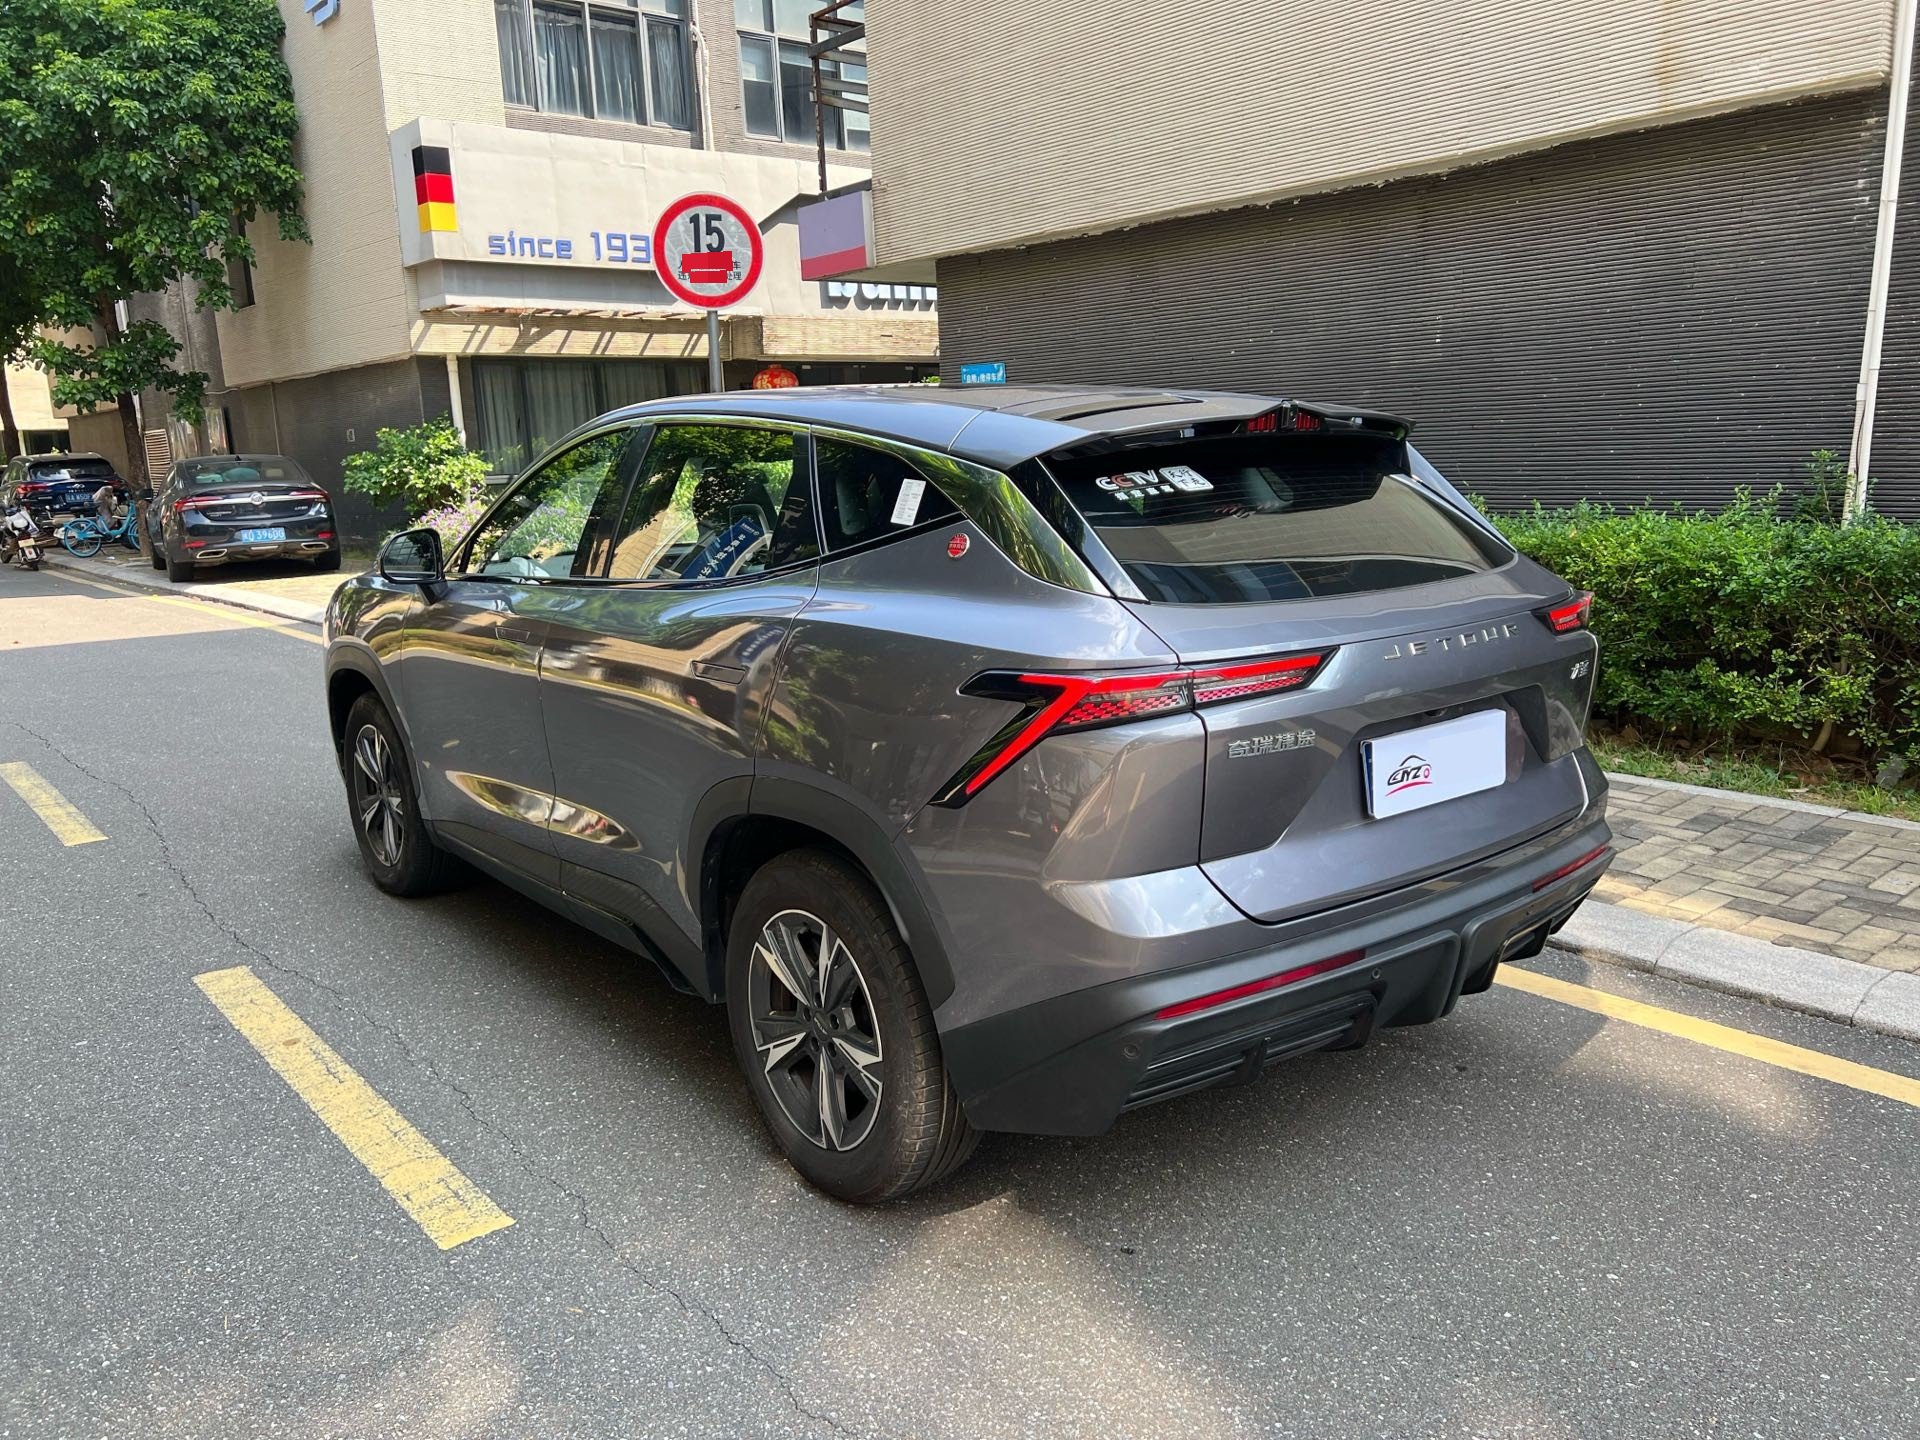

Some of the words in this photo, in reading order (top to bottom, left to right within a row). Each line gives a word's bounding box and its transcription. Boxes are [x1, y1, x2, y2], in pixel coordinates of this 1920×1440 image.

[488, 230, 572, 259] since
[590, 231, 651, 263] 193
[689, 213, 725, 253] 15
[1095, 469, 1159, 491] CCTV
[1383, 623, 1521, 660] JETOUR
[1227, 728, 1317, 759] 奇瑞捷途
